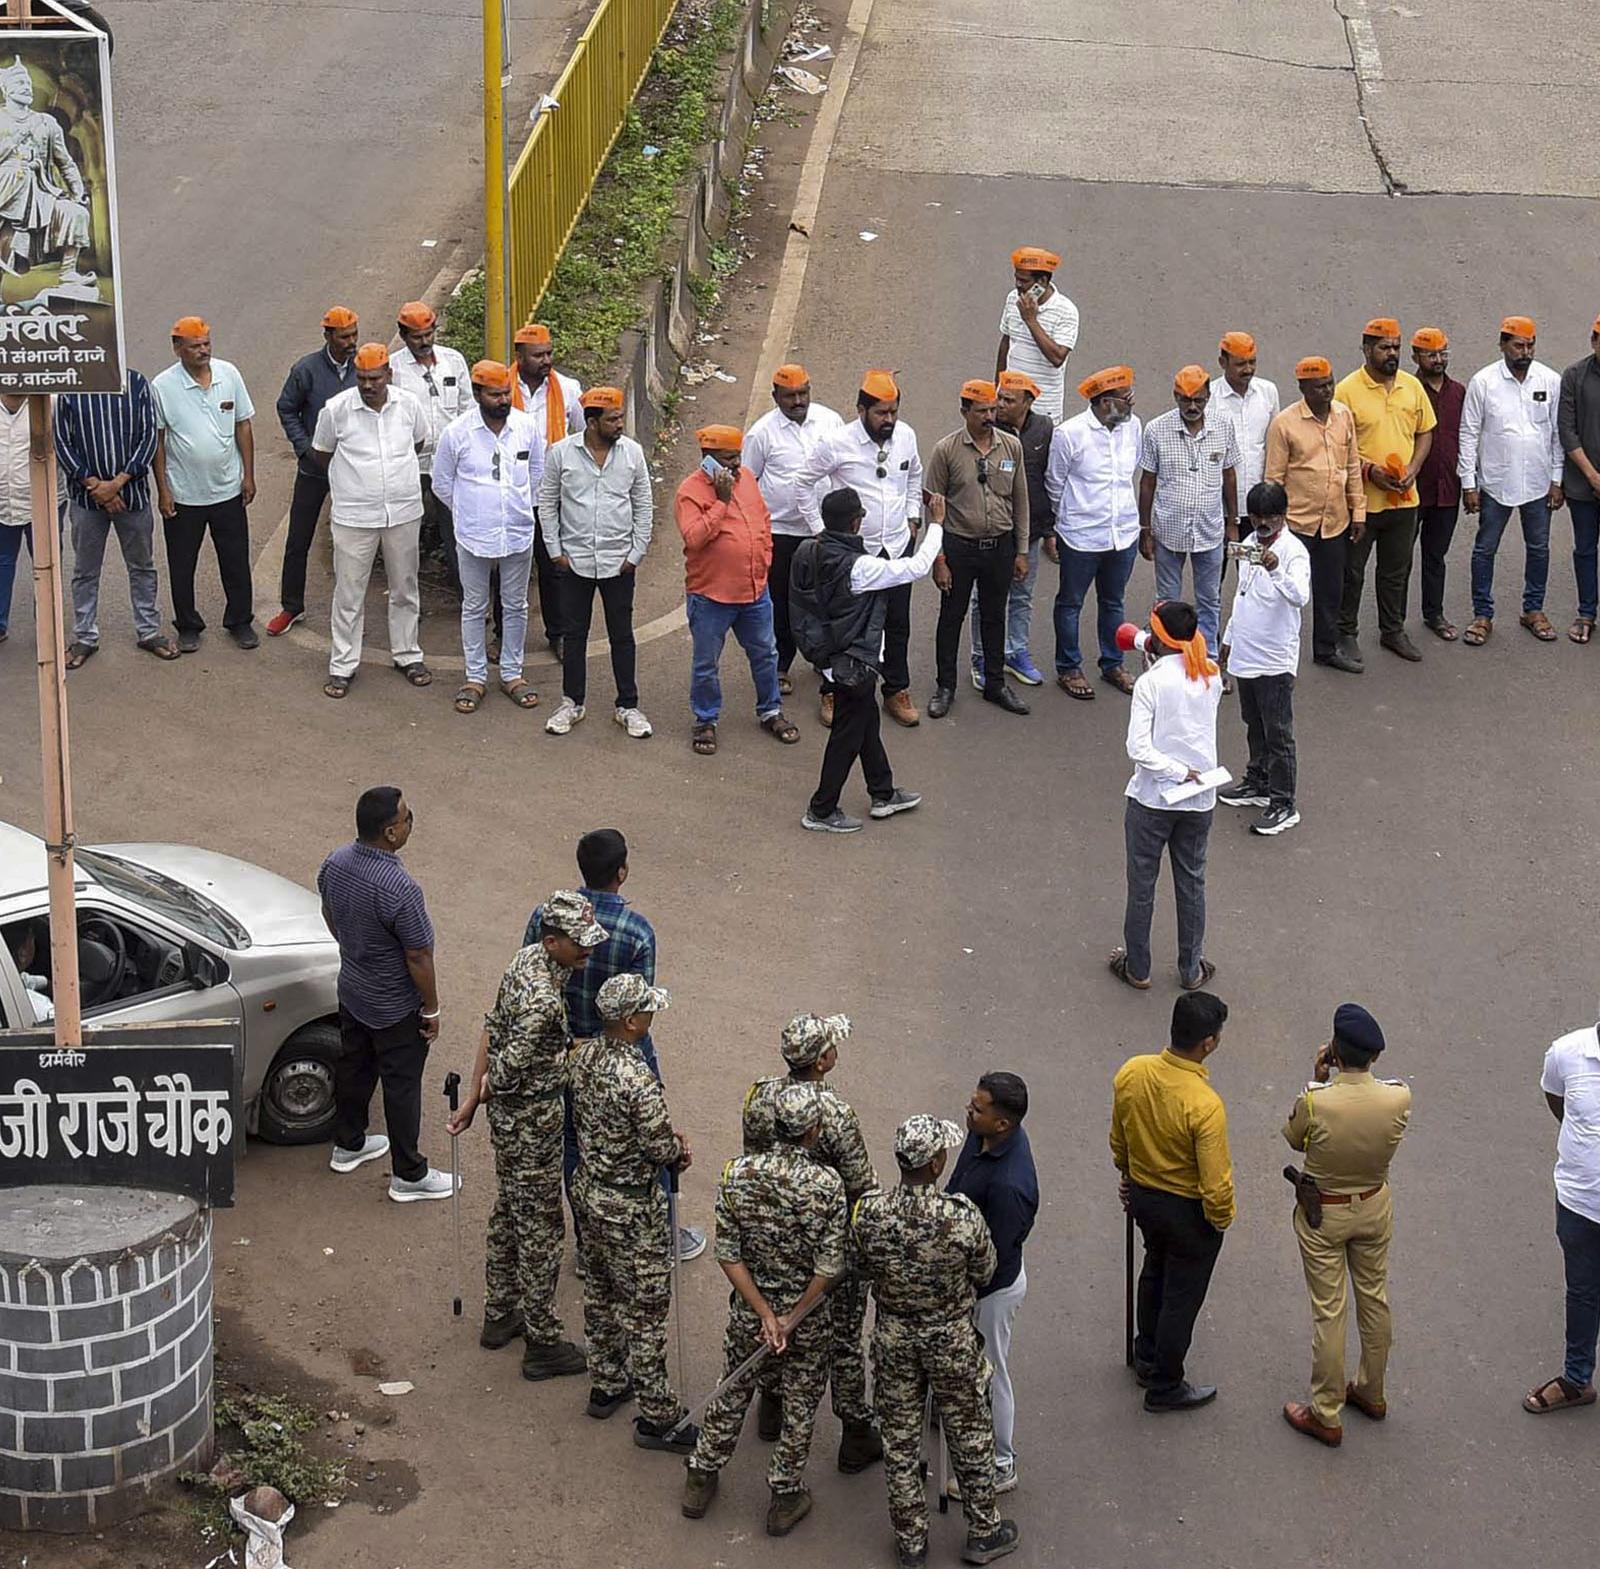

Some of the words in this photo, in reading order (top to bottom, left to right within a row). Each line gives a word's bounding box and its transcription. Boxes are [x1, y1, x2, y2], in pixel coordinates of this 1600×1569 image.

[11, 346, 71, 366] संभाजी
[74, 345, 106, 364] राजे
[38, 1050, 87, 1070] धर्मवीर
[56, 1075, 142, 1160] राजे
[144, 1072, 233, 1158] चौक
